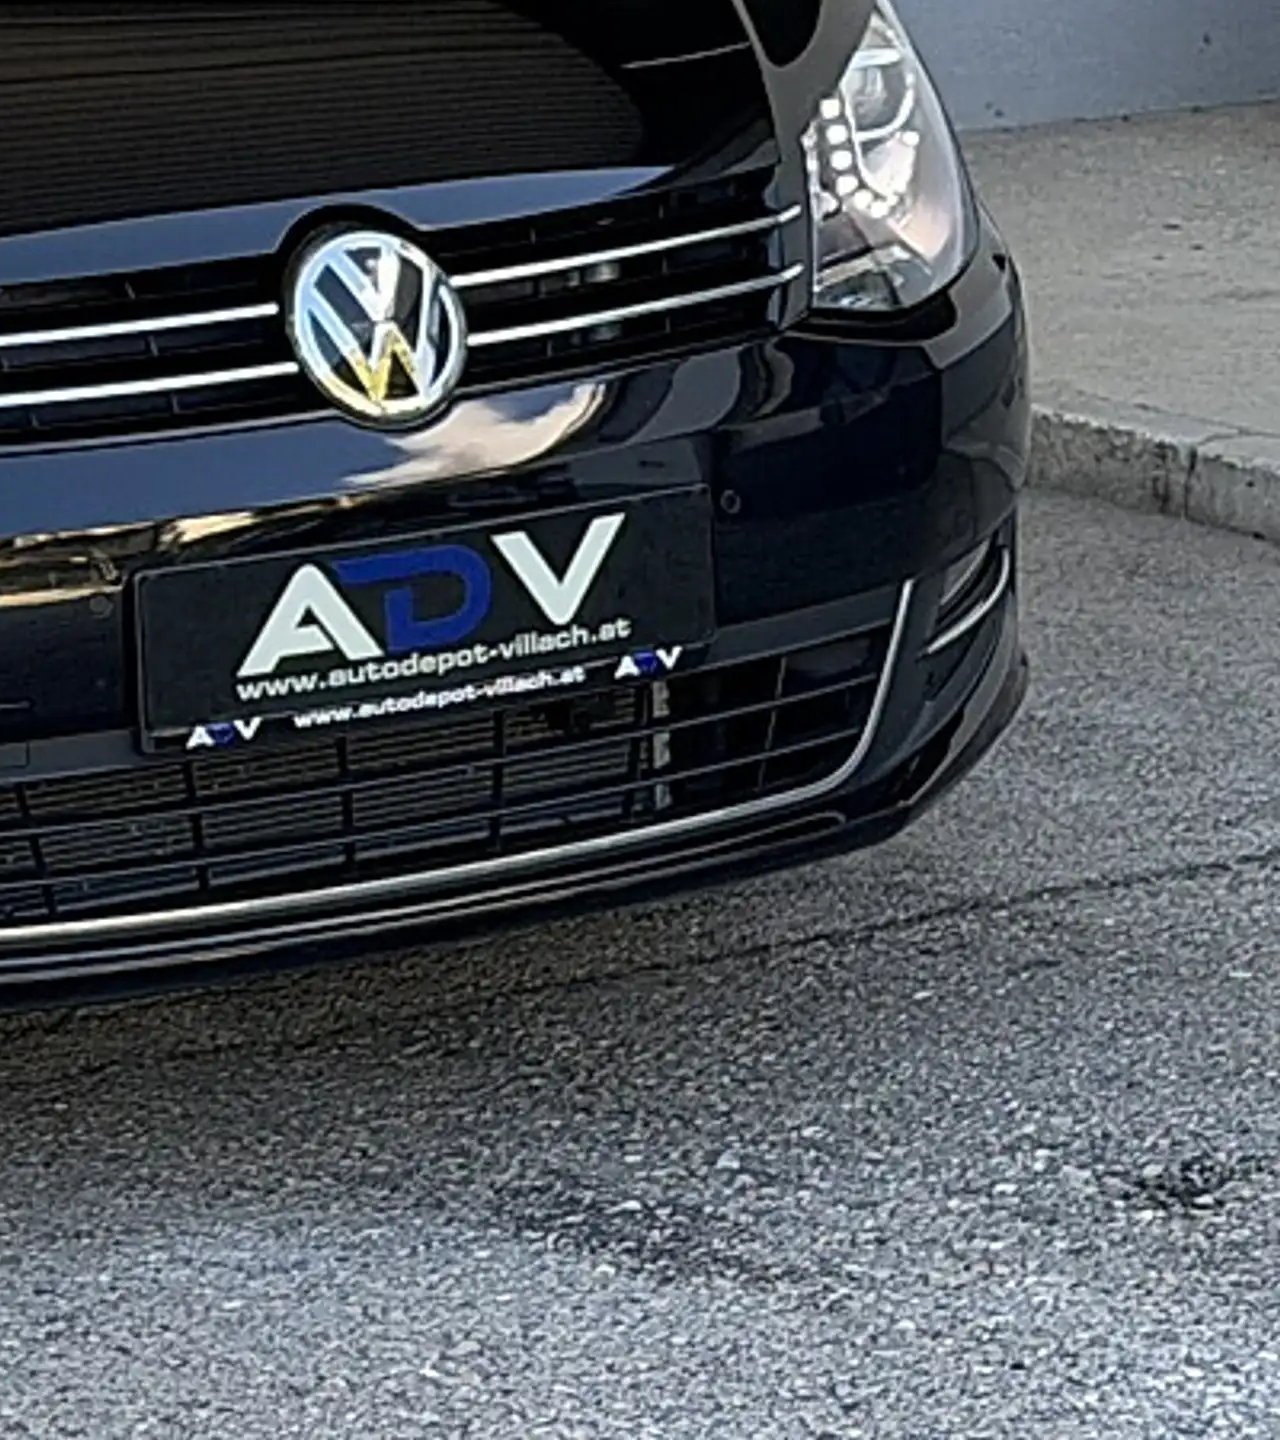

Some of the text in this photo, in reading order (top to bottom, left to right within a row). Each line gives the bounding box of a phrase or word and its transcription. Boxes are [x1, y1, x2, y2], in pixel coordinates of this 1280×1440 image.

[237, 513, 625, 678] ADV
[236, 616, 633, 703] www.autodepot-villach.at
[292, 663, 588, 730] www.autodepot-villach.at
